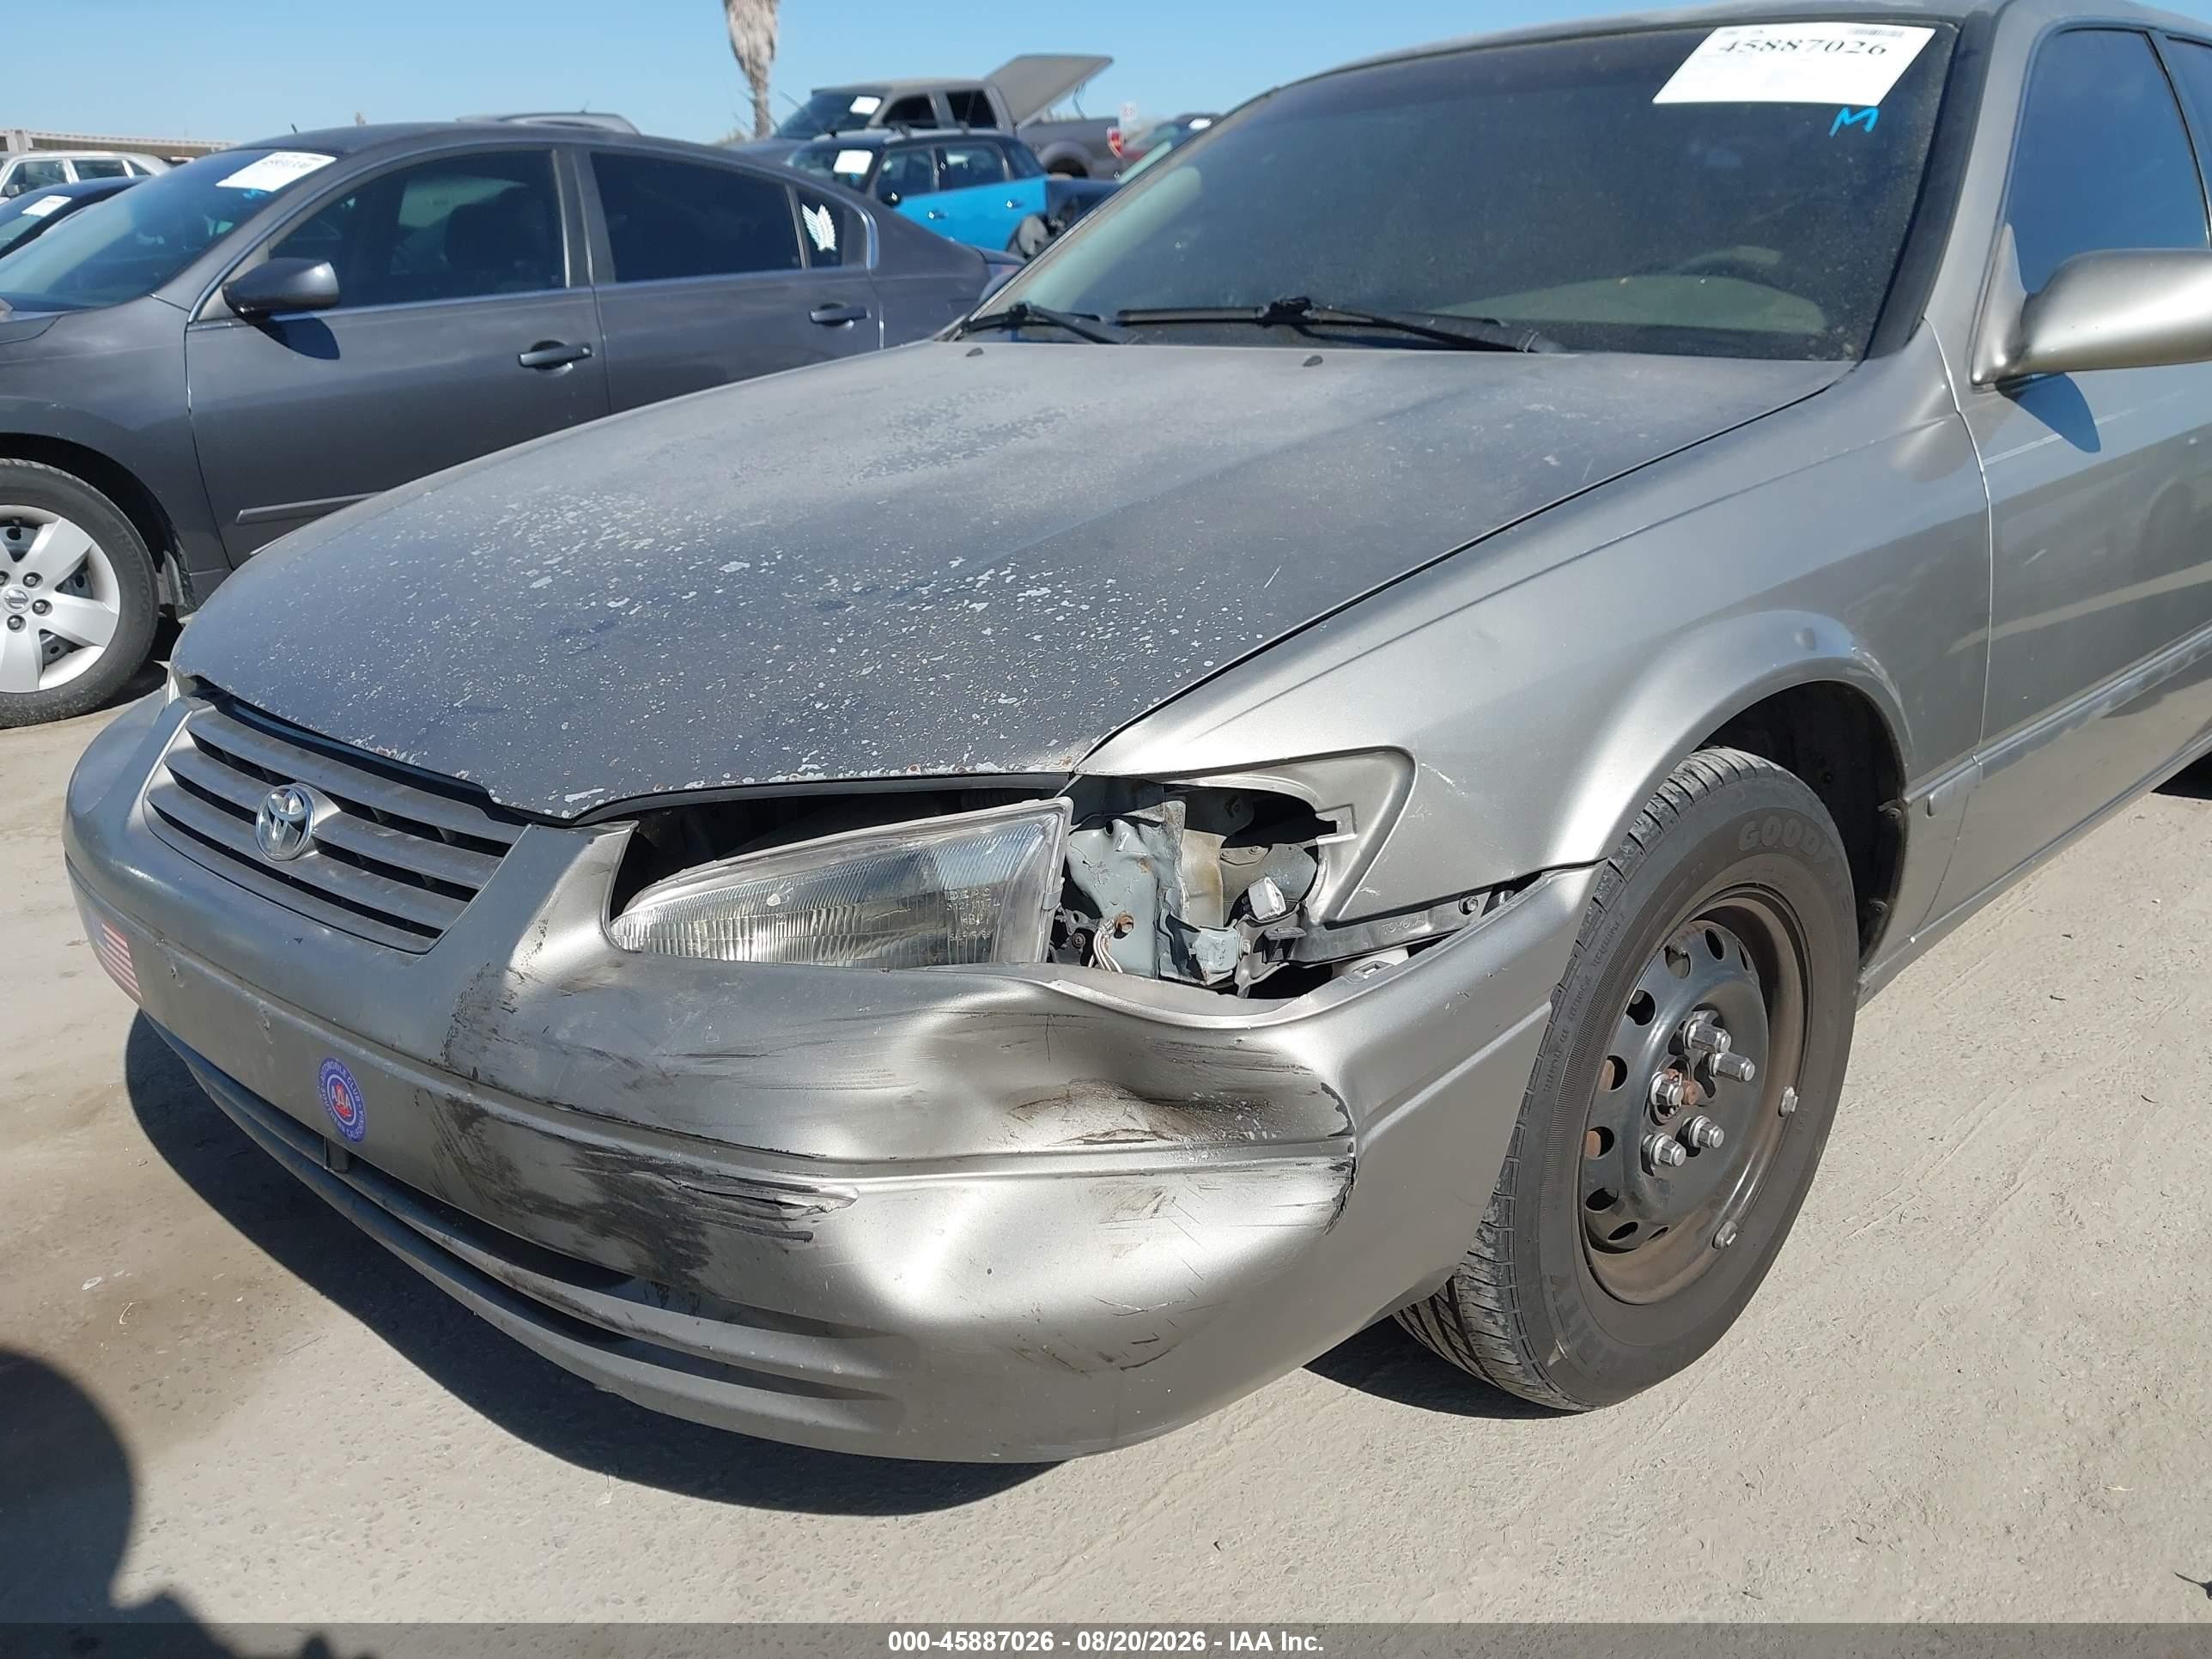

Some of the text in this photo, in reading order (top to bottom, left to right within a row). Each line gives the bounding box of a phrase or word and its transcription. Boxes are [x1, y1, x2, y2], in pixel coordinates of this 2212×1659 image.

[1719, 40, 1887, 55] 45887026
[1828, 106, 1880, 137] M
[947, 887, 990, 900] DEPO
[1381, 915, 1425, 934] TOYOTA
[331, 1085, 353, 1112] AAA
[347, 1076, 362, 1102] CLUB
